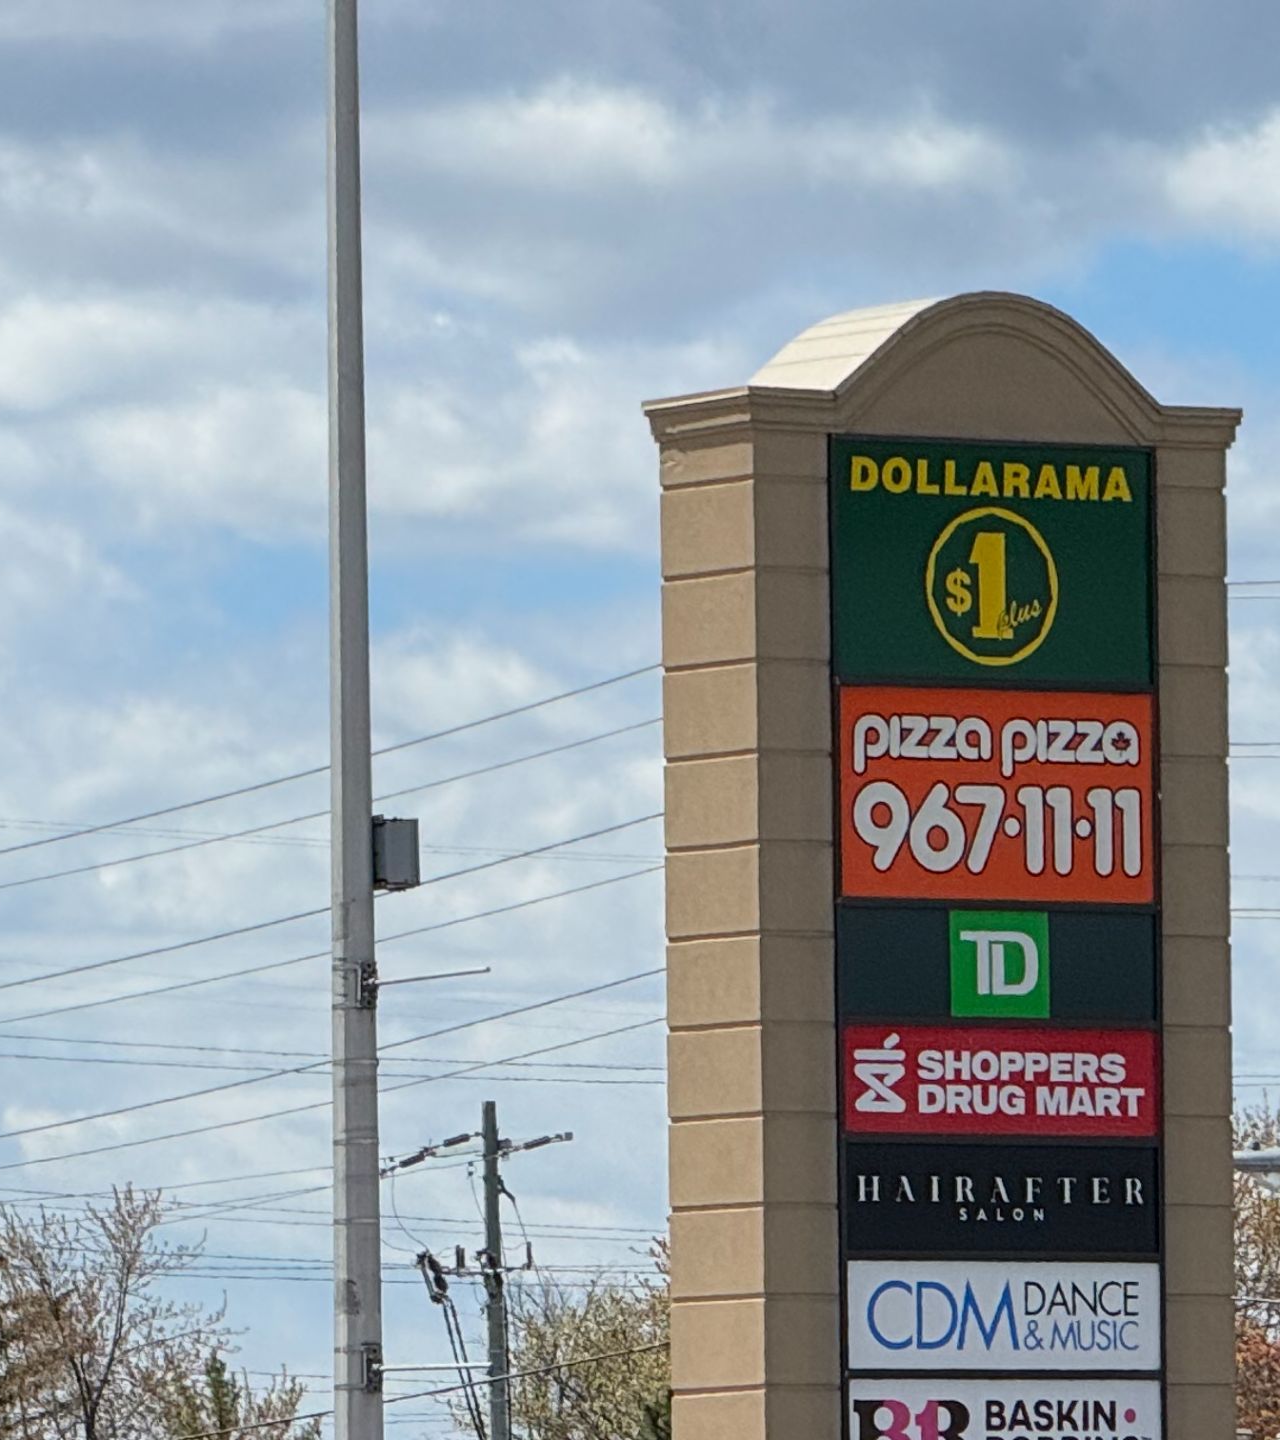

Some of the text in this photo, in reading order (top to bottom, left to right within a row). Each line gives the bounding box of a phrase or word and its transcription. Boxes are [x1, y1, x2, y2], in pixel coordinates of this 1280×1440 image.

[850, 456, 1133, 502] DOLLARAMA
[996, 599, 1043, 640] plus
[852, 713, 1140, 778] pizza pizza
[959, 930, 1039, 995] TD
[917, 1050, 1126, 1084] SHOPPERS
[918, 1084, 1145, 1117] DRUG MART
[857, 1175, 1144, 1205] HAIRAFTER
[959, 1207, 1045, 1221] SALON
[867, 1279, 1020, 1351] CDM
[1024, 1281, 1140, 1316] DANCE
[1024, 1319, 1140, 1351] & MUSIC
